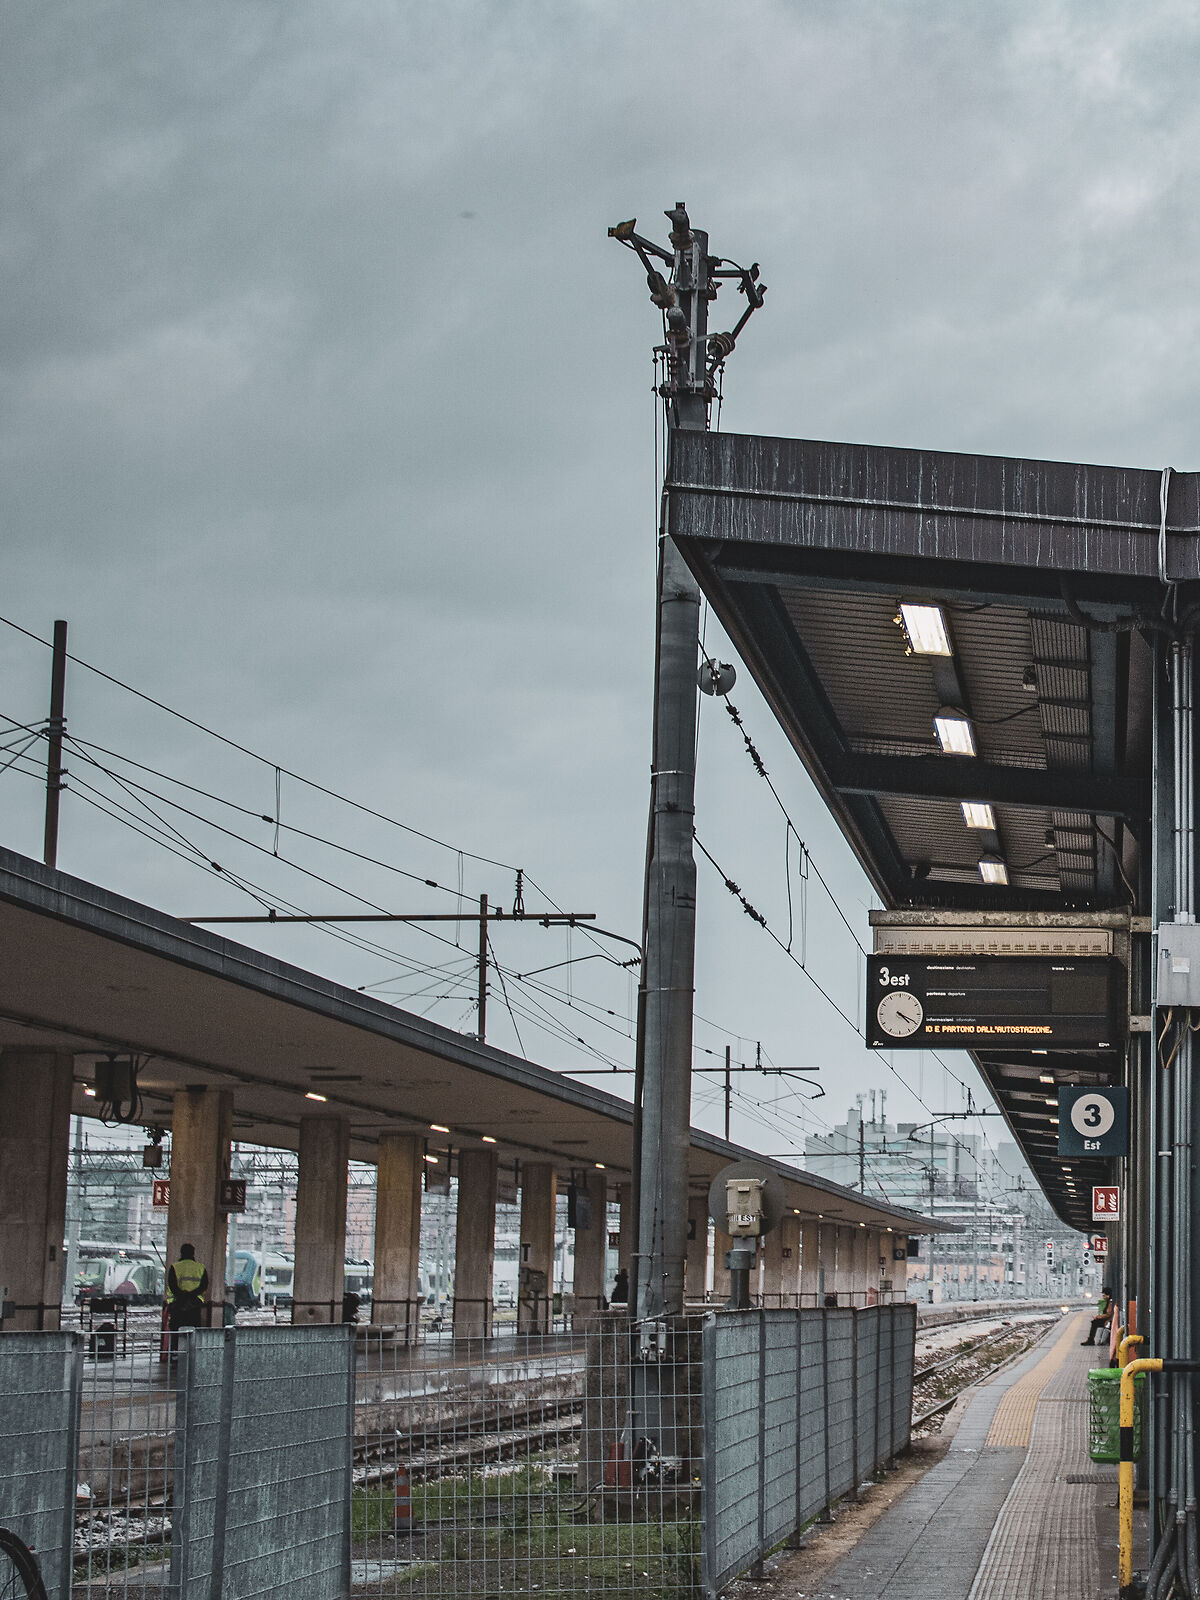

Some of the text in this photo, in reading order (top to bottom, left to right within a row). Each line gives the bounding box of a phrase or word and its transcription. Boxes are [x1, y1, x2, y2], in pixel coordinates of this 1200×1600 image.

[934, 1025, 941, 1033] E
[942, 1025, 975, 1033] PARTONO
[976, 1025, 1053, 1034] DALL'AUTOSTAZIONE.
[1083, 1104, 1102, 1127] 3
[1084, 1140, 1101, 1151] Est
